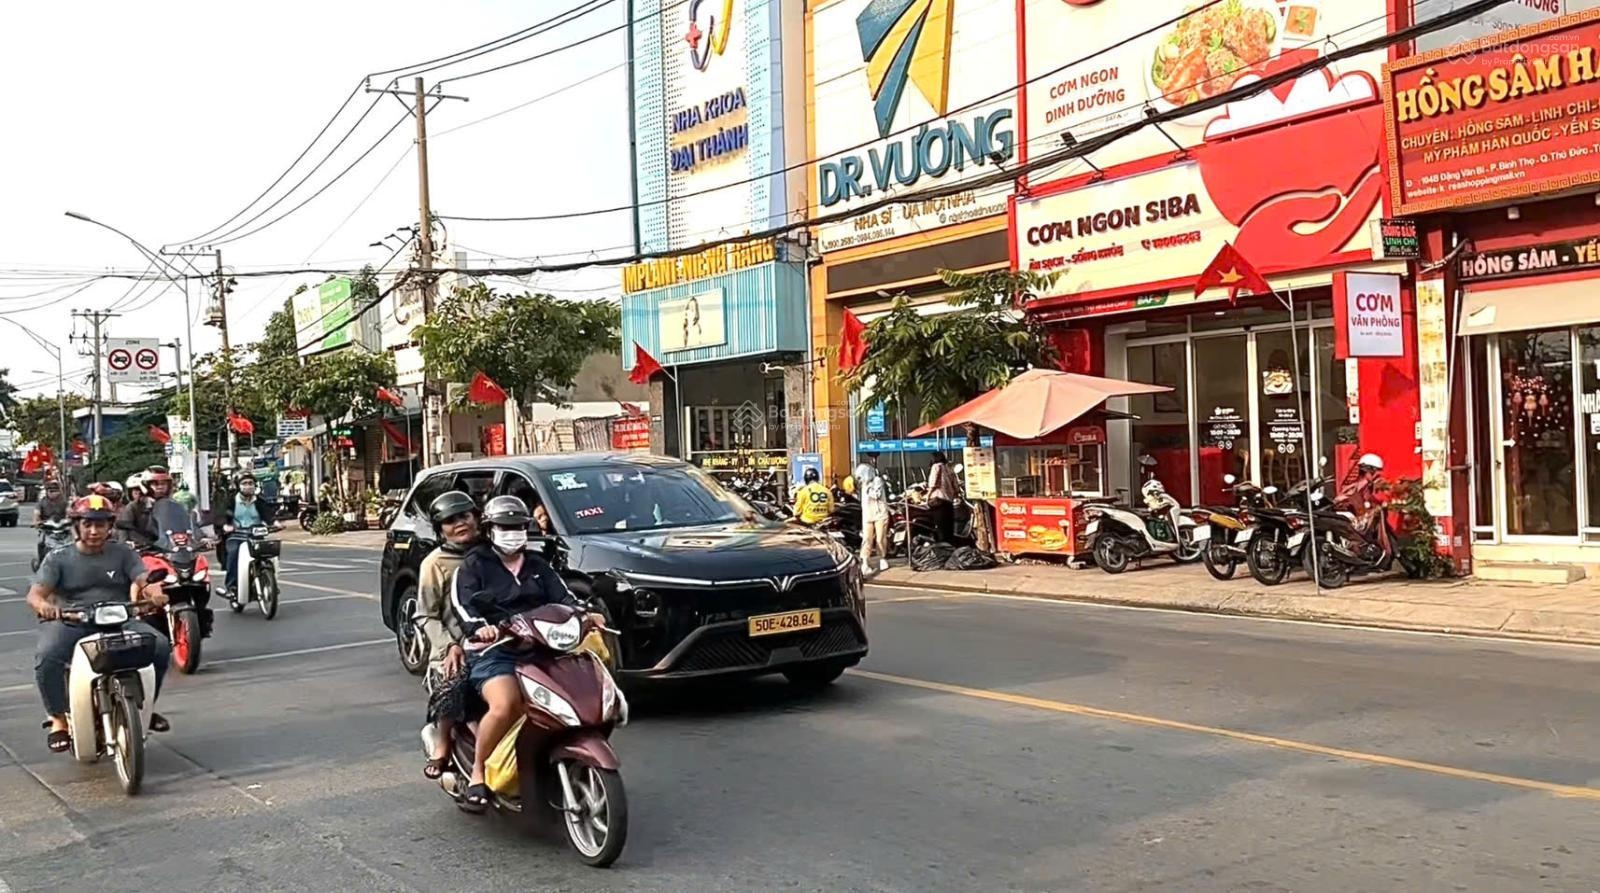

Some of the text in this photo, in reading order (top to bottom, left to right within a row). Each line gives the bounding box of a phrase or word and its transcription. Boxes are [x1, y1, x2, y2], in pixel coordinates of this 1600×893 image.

[1049, 66, 1118, 99] CƠM NGON
[1396, 68, 1485, 122] HỒNG
[1488, 53, 1562, 101] SÂM
[673, 86, 747, 133] NHA KHOA
[1045, 88, 1125, 124] DINH DƯỠNG
[1458, 117, 1493, 139] HỒNG
[1496, 112, 1524, 130] SÂM
[1532, 106, 1562, 123] LINH
[696, 122, 749, 162] THÀNH
[1424, 147, 1440, 164] MỸ
[1443, 138, 1479, 159] PHẨM
[1482, 134, 1509, 152] HÀN
[1512, 123, 1551, 146] QUỐC
[1561, 116, 1589, 136] YẾN
[1027, 193, 1202, 246] CƠM NGON SIBA
[1462, 253, 1515, 277] HỒNG
[1518, 247, 1558, 270] SÂM
[1356, 293, 1393, 312] CƠM
[1351, 313, 1400, 327] VĂN PHÒNG
[755, 612, 815, 632] 50E-428.84
